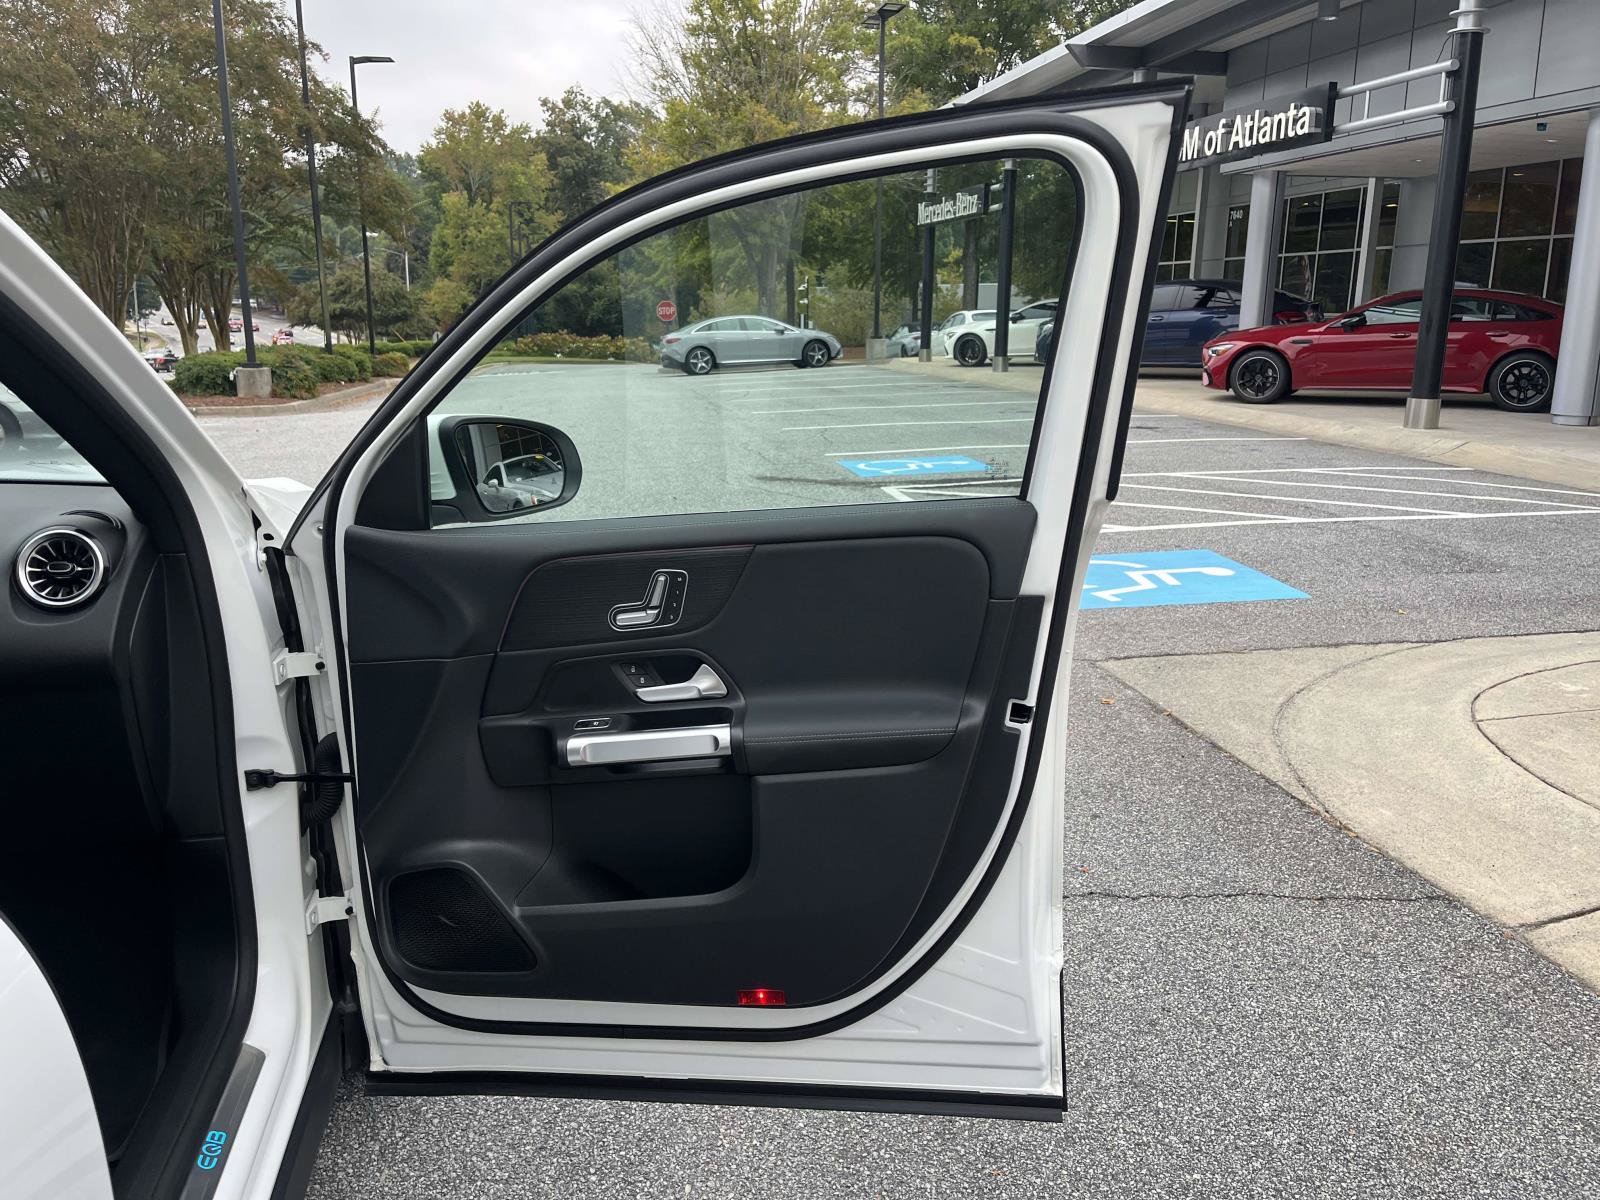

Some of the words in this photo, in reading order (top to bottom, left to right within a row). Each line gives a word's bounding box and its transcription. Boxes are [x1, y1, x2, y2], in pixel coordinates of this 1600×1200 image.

[1178, 125, 1200, 161] M
[1204, 118, 1227, 156] of
[1228, 102, 1311, 151] Atlanta
[917, 192, 978, 226] Mercedes-Benz
[658, 306, 676, 315] STOP
[197, 1130, 227, 1169] EQB
